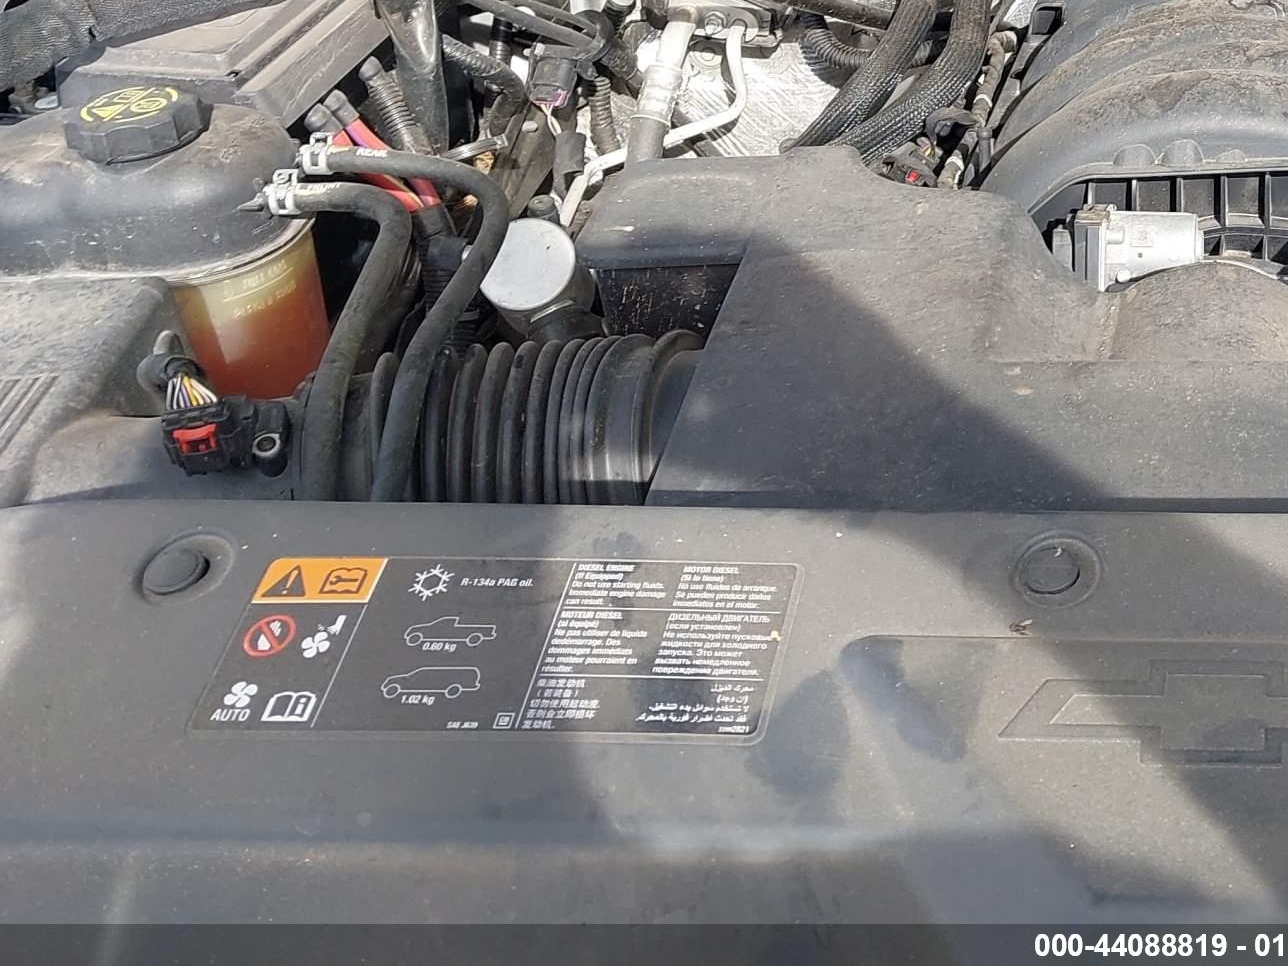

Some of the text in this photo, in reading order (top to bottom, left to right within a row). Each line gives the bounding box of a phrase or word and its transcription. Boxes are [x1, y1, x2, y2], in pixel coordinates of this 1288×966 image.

[606, 564, 635, 572] ENGINE
[460, 578, 534, 587] R-134a PAG oil.
[612, 581, 641, 589] starting
[743, 585, 778, 593] arranque.
[609, 590, 635, 598] engine
[636, 590, 666, 599] damage
[560, 611, 623, 619] MOTEUR DIESEL
[622, 630, 648, 638] liquide
[422, 642, 457, 652] 0.60 kg
[548, 647, 632, 655] dommages immédiats
[585, 657, 626, 665] pourraient
[401, 695, 435, 705] 1.02 kg
[210, 708, 250, 721] AUTO
